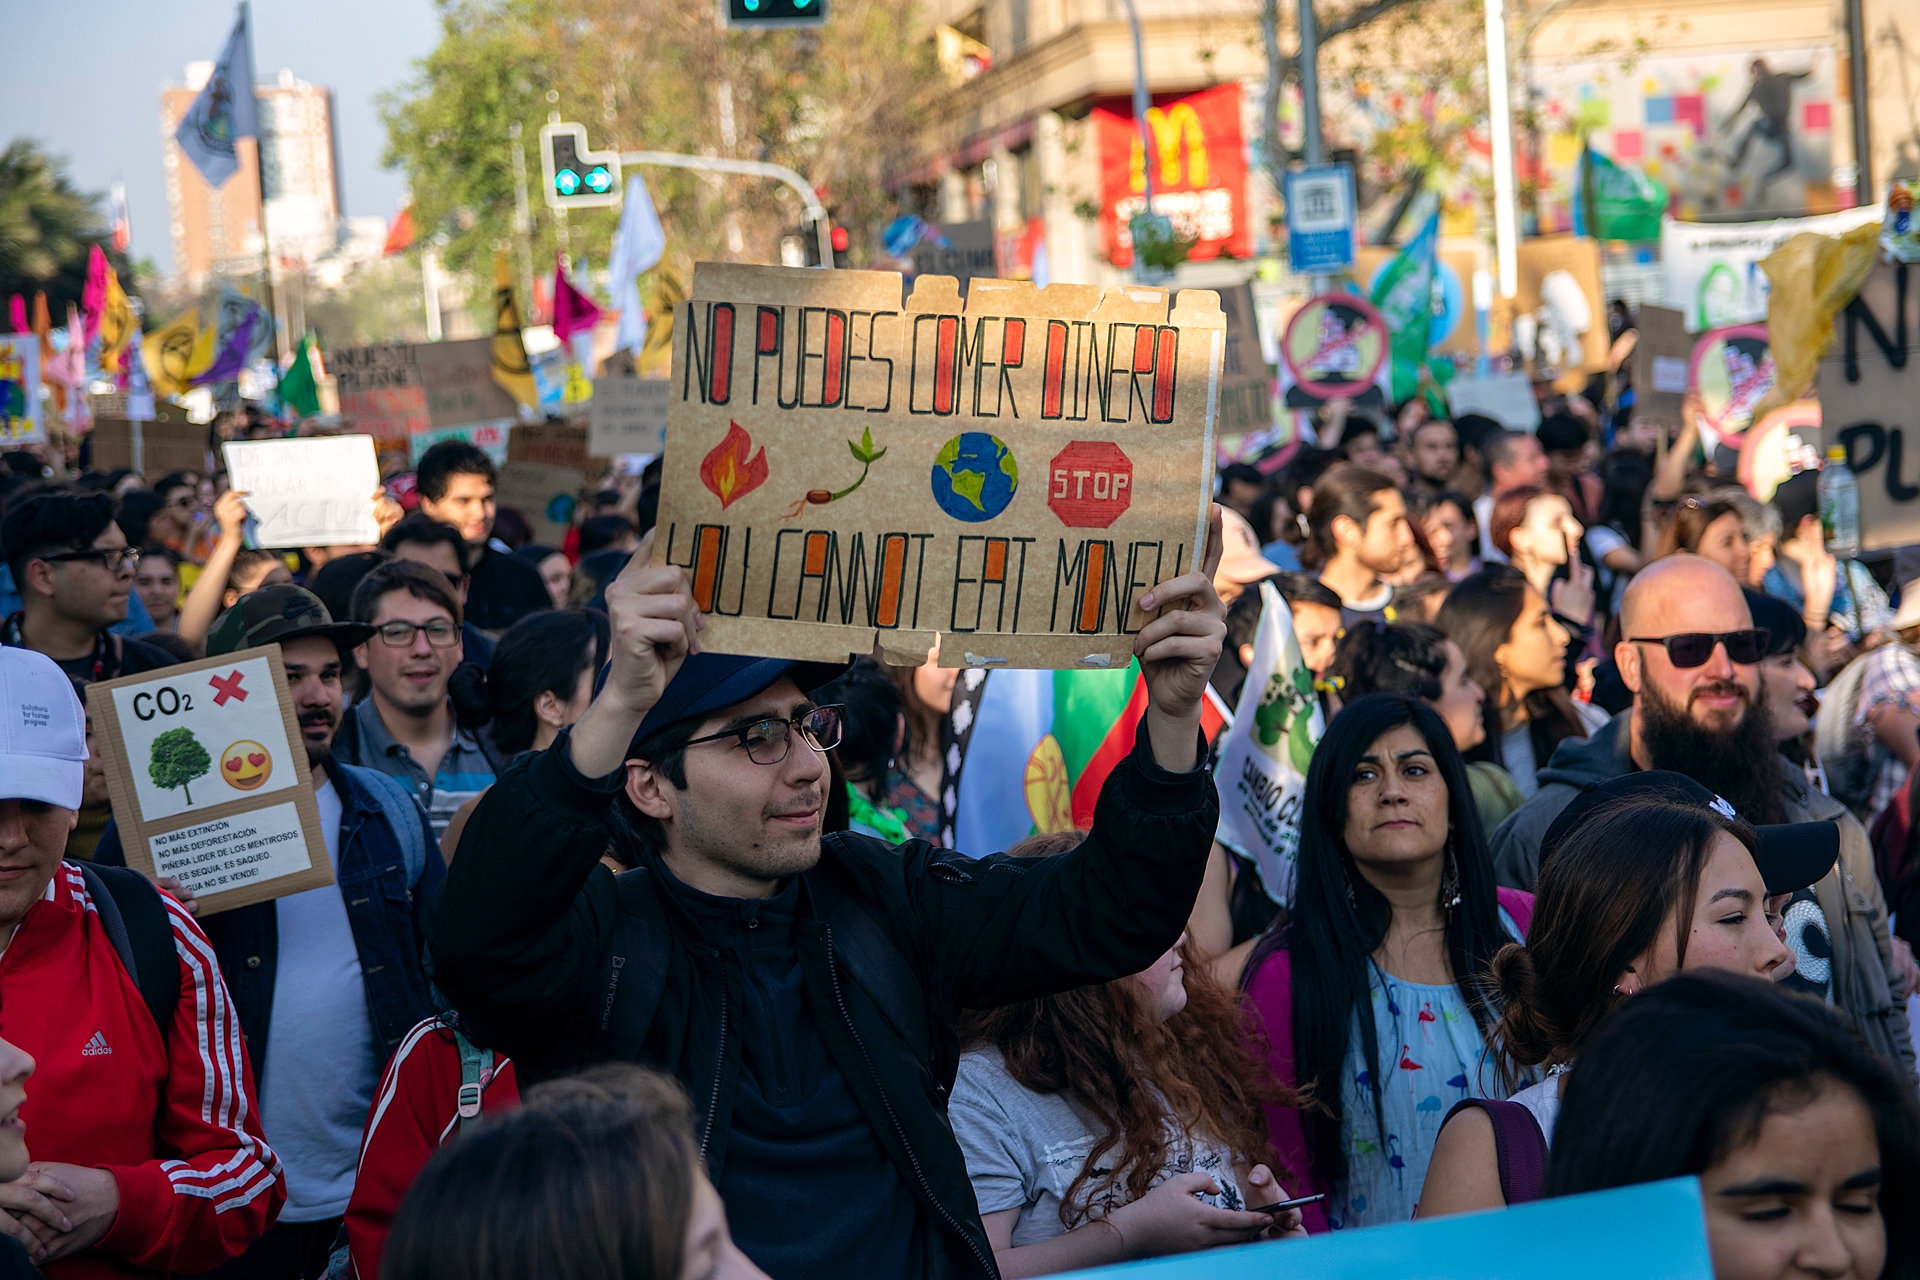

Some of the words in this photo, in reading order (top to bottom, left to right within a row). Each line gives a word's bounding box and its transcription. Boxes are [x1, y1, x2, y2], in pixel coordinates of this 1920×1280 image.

[683, 301, 737, 406] NO
[752, 305, 899, 413] PUEDES
[909, 313, 1028, 419] COMER
[1041, 318, 1179, 424] DINERO
[1053, 468, 1128, 501] STOP
[665, 522, 752, 617] YOU
[767, 528, 935, 629] CANNOT
[950, 535, 1036, 634] EAT
[1049, 537, 1184, 636] MONEY
[155, 836, 168, 846] NO
[169, 831, 187, 843] MÁS
[187, 820, 230, 839] EXTINCIÓN
[158, 849, 171, 859] NO
[172, 844, 190, 856] MÁS
[191, 827, 258, 852] DEFORESTACIÓN
[161, 857, 191, 872] PIÑERA
[193, 853, 217, 864] LIDER
[217, 849, 229, 858] DE
[230, 843, 247, 855] LOS
[247, 829, 299, 850] MENTIROSOS
[178, 872, 190, 881] ES
[224, 861, 236, 870] ES
[236, 850, 273, 866] SAQUEO.
[204, 878, 217, 888] NO
[218, 874, 230, 884] SE
[230, 867, 260, 881] VENDE!
[601, 969, 620, 1031] SAXOLINE
[81, 1046, 113, 1056] adidas
